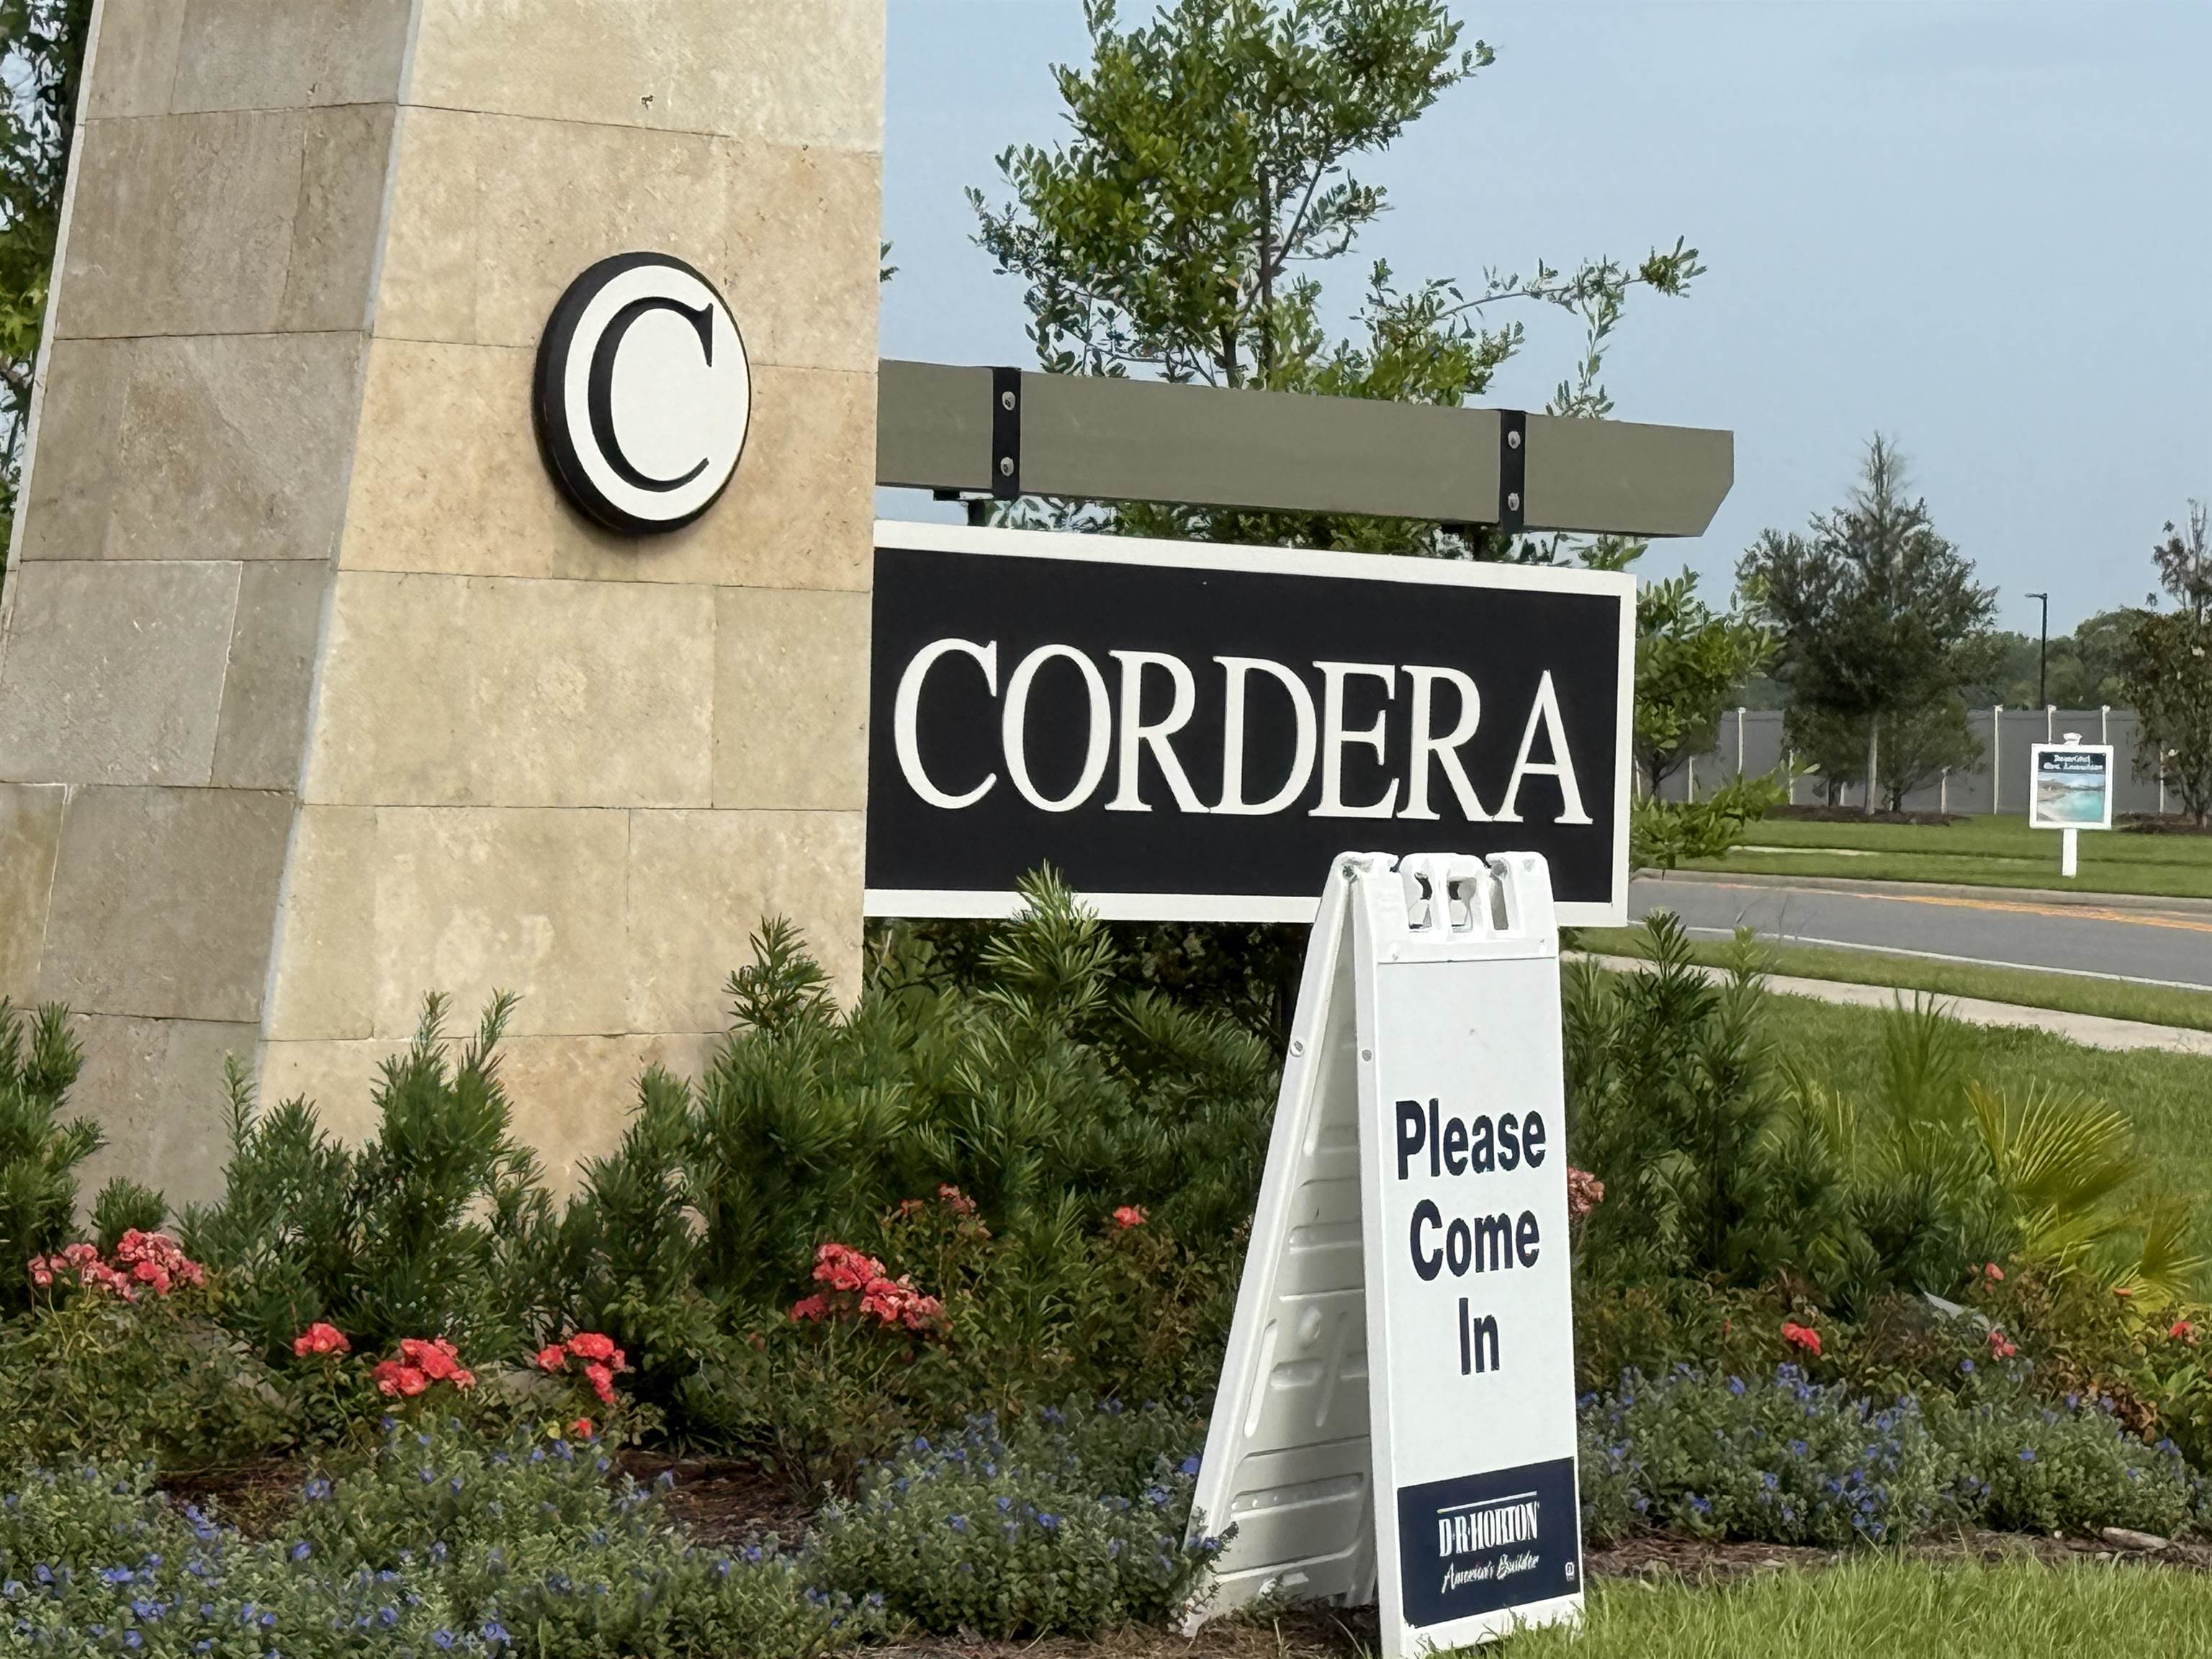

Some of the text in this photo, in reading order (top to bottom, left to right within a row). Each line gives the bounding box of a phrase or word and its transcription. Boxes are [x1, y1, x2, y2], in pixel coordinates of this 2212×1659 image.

[588, 302, 714, 493] C
[894, 638, 1593, 824] CORDERA
[1395, 1097, 1546, 1179] Please
[1410, 1198, 1539, 1281] Come
[1458, 1297, 1500, 1375] In
[1496, 1550, 1540, 1581] Builder
